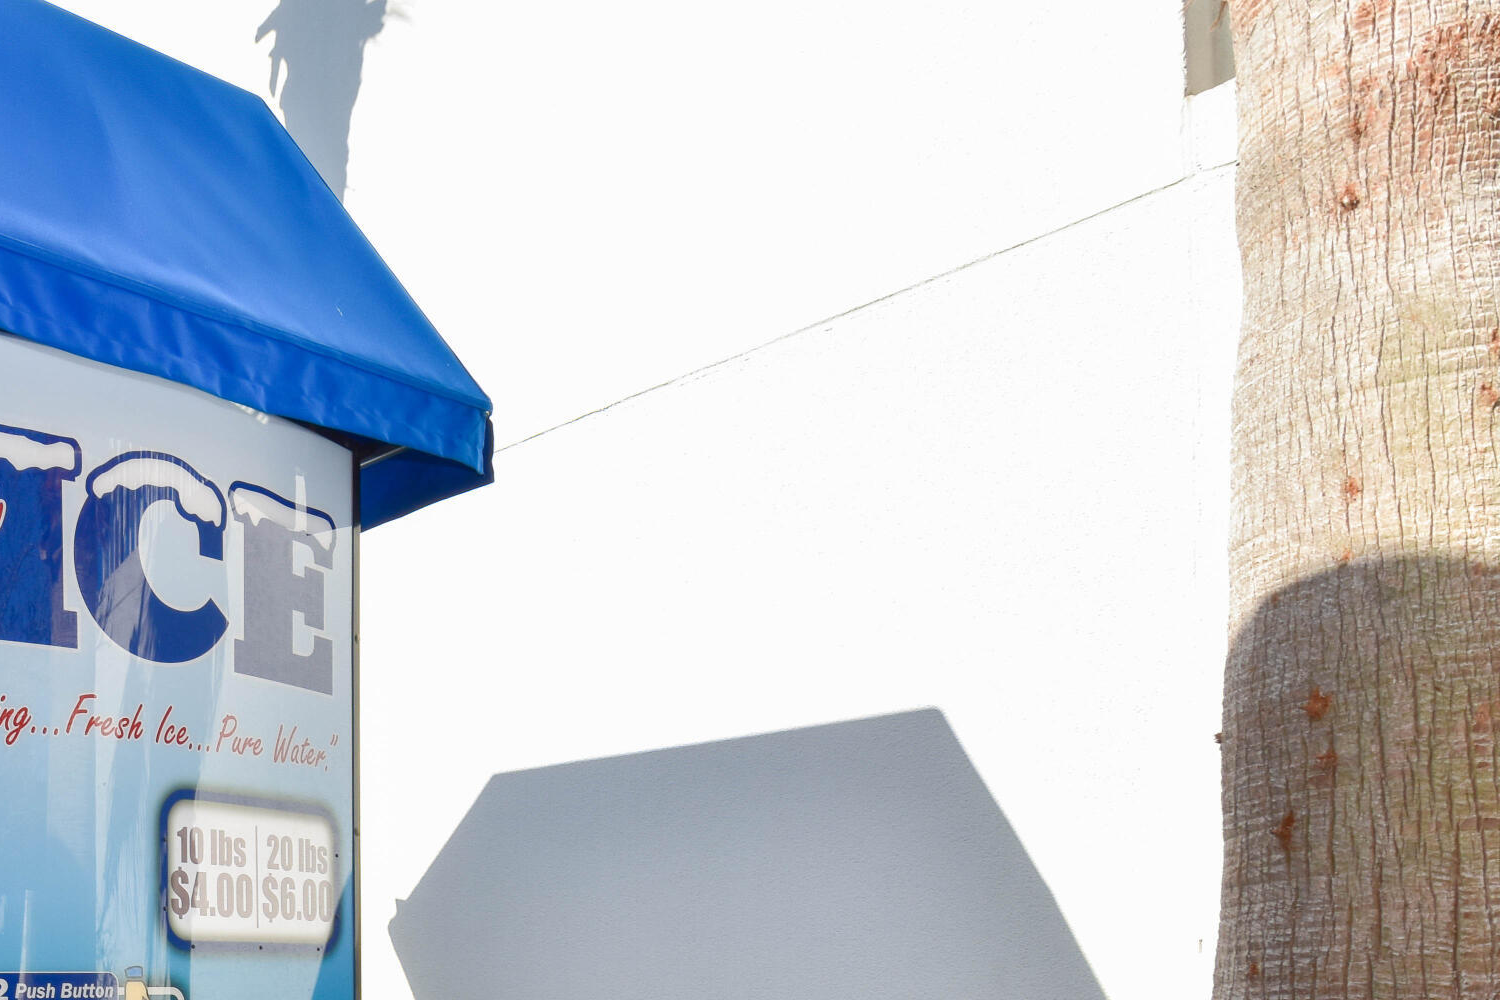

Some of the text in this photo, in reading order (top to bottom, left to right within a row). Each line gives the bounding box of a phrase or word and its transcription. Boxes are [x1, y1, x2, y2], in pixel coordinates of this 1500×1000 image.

[177, 827, 246, 867] 10 lbs
[267, 835, 328, 874] 20 lbs
[171, 867, 253, 919] $4.00
[262, 873, 333, 923] $6.00
[15, 982, 56, 1000] Push
[60, 982, 114, 999] Button
